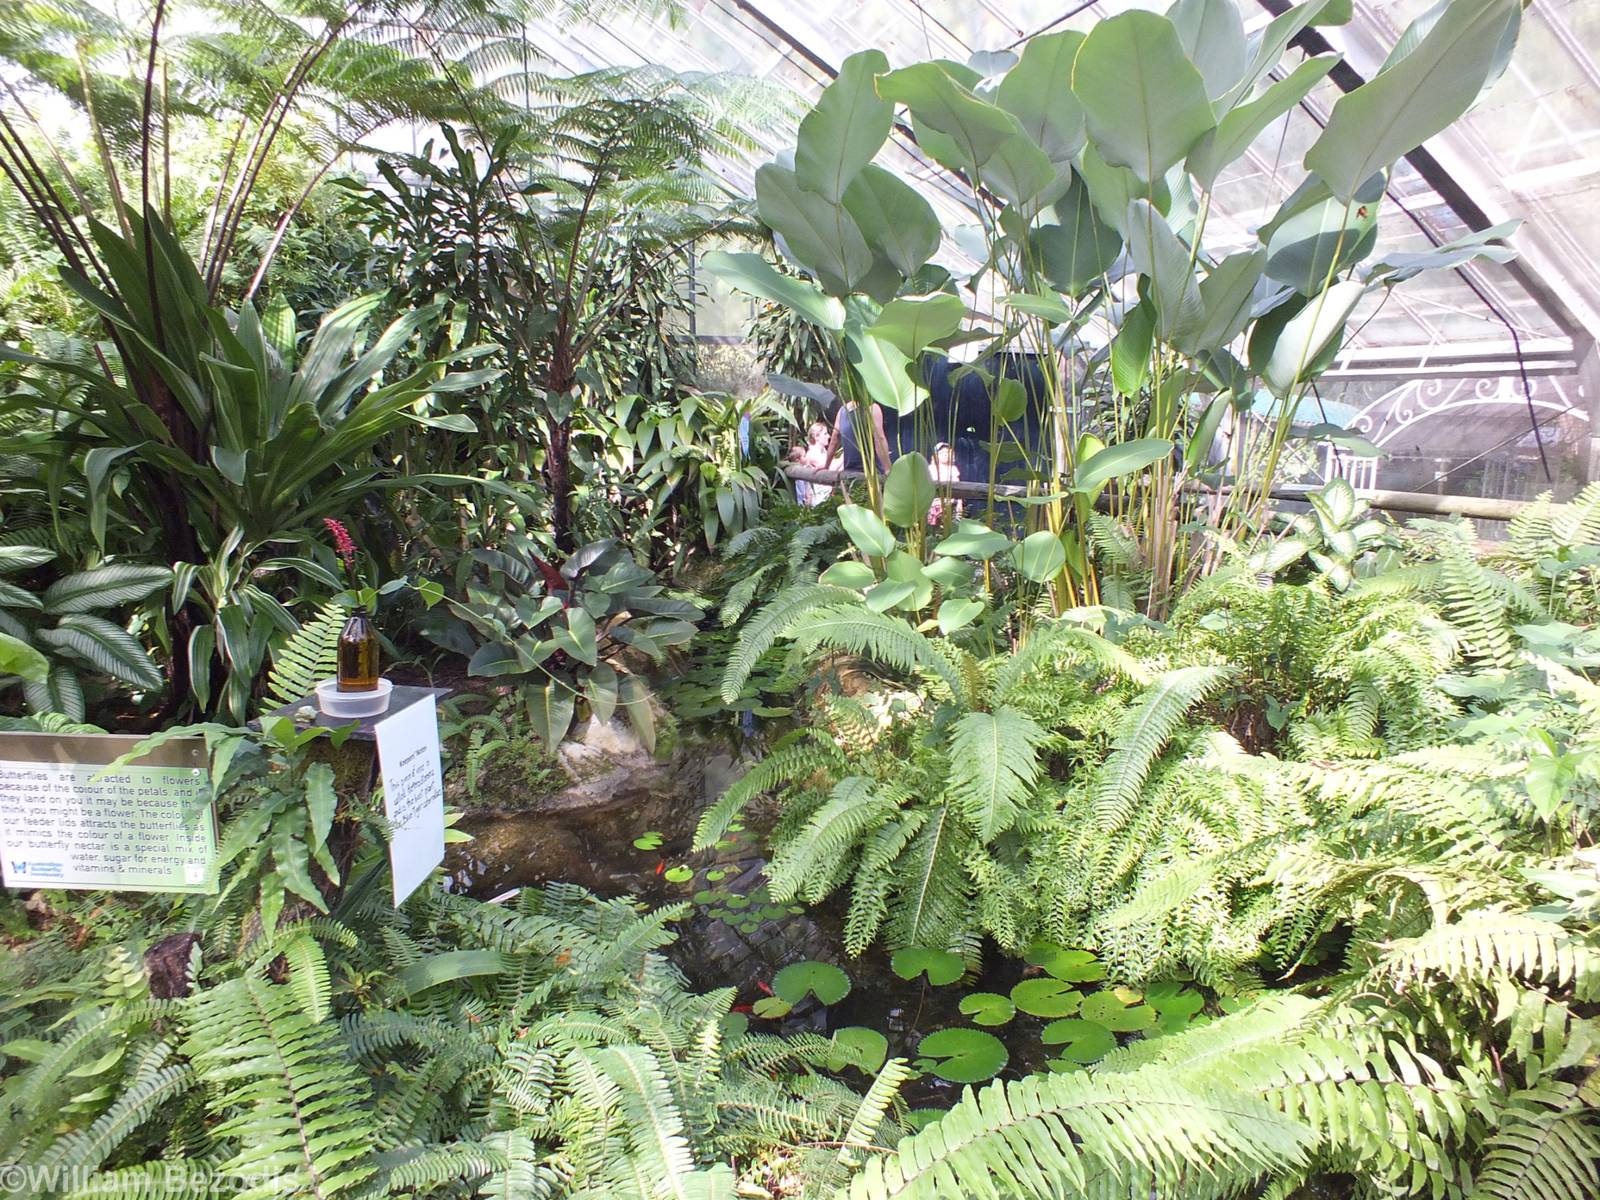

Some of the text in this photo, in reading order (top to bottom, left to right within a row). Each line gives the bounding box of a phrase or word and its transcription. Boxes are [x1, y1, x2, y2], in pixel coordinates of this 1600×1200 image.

[59, 773, 76, 782] are
[142, 776, 151, 785] to
[162, 776, 201, 786] flowers
[42, 783, 51, 792] of
[54, 784, 70, 793] the
[73, 785, 104, 794] colour
[107, 786, 117, 794] of
[119, 786, 135, 795] the
[174, 788, 192, 797] and
[0, 794, 20, 804] they
[24, 794, 46, 803] land
[49, 796, 61, 804] on
[66, 797, 83, 806] you
[87, 796, 93, 805] it
[96, 798, 117, 808] may
[121, 797, 133, 806] be
[137, 798, 178, 808] because
[29, 807, 47, 817] you
[49, 807, 78, 818] might
[81, 808, 93, 817] be
[95, 809, 102, 817] a
[140, 809, 158, 819] The
[160, 810, 185, 820] colo
[3, 816, 205, 832] our feeder lids attracts the butterflies as
[16, 828, 52, 838] mimics
[57, 829, 73, 839] the
[78, 830, 109, 840] colour
[113, 831, 123, 840] of
[127, 833, 134, 841] a
[7, 840, 208, 854] our butterfly nectar is a special mix of
[104, 854, 132, 865] sugar
[134, 854, 148, 863] for
[151, 856, 184, 866] energy
[187, 857, 206, 866] and
[74, 862, 117, 873] vitamins
[118, 865, 125, 873] &
